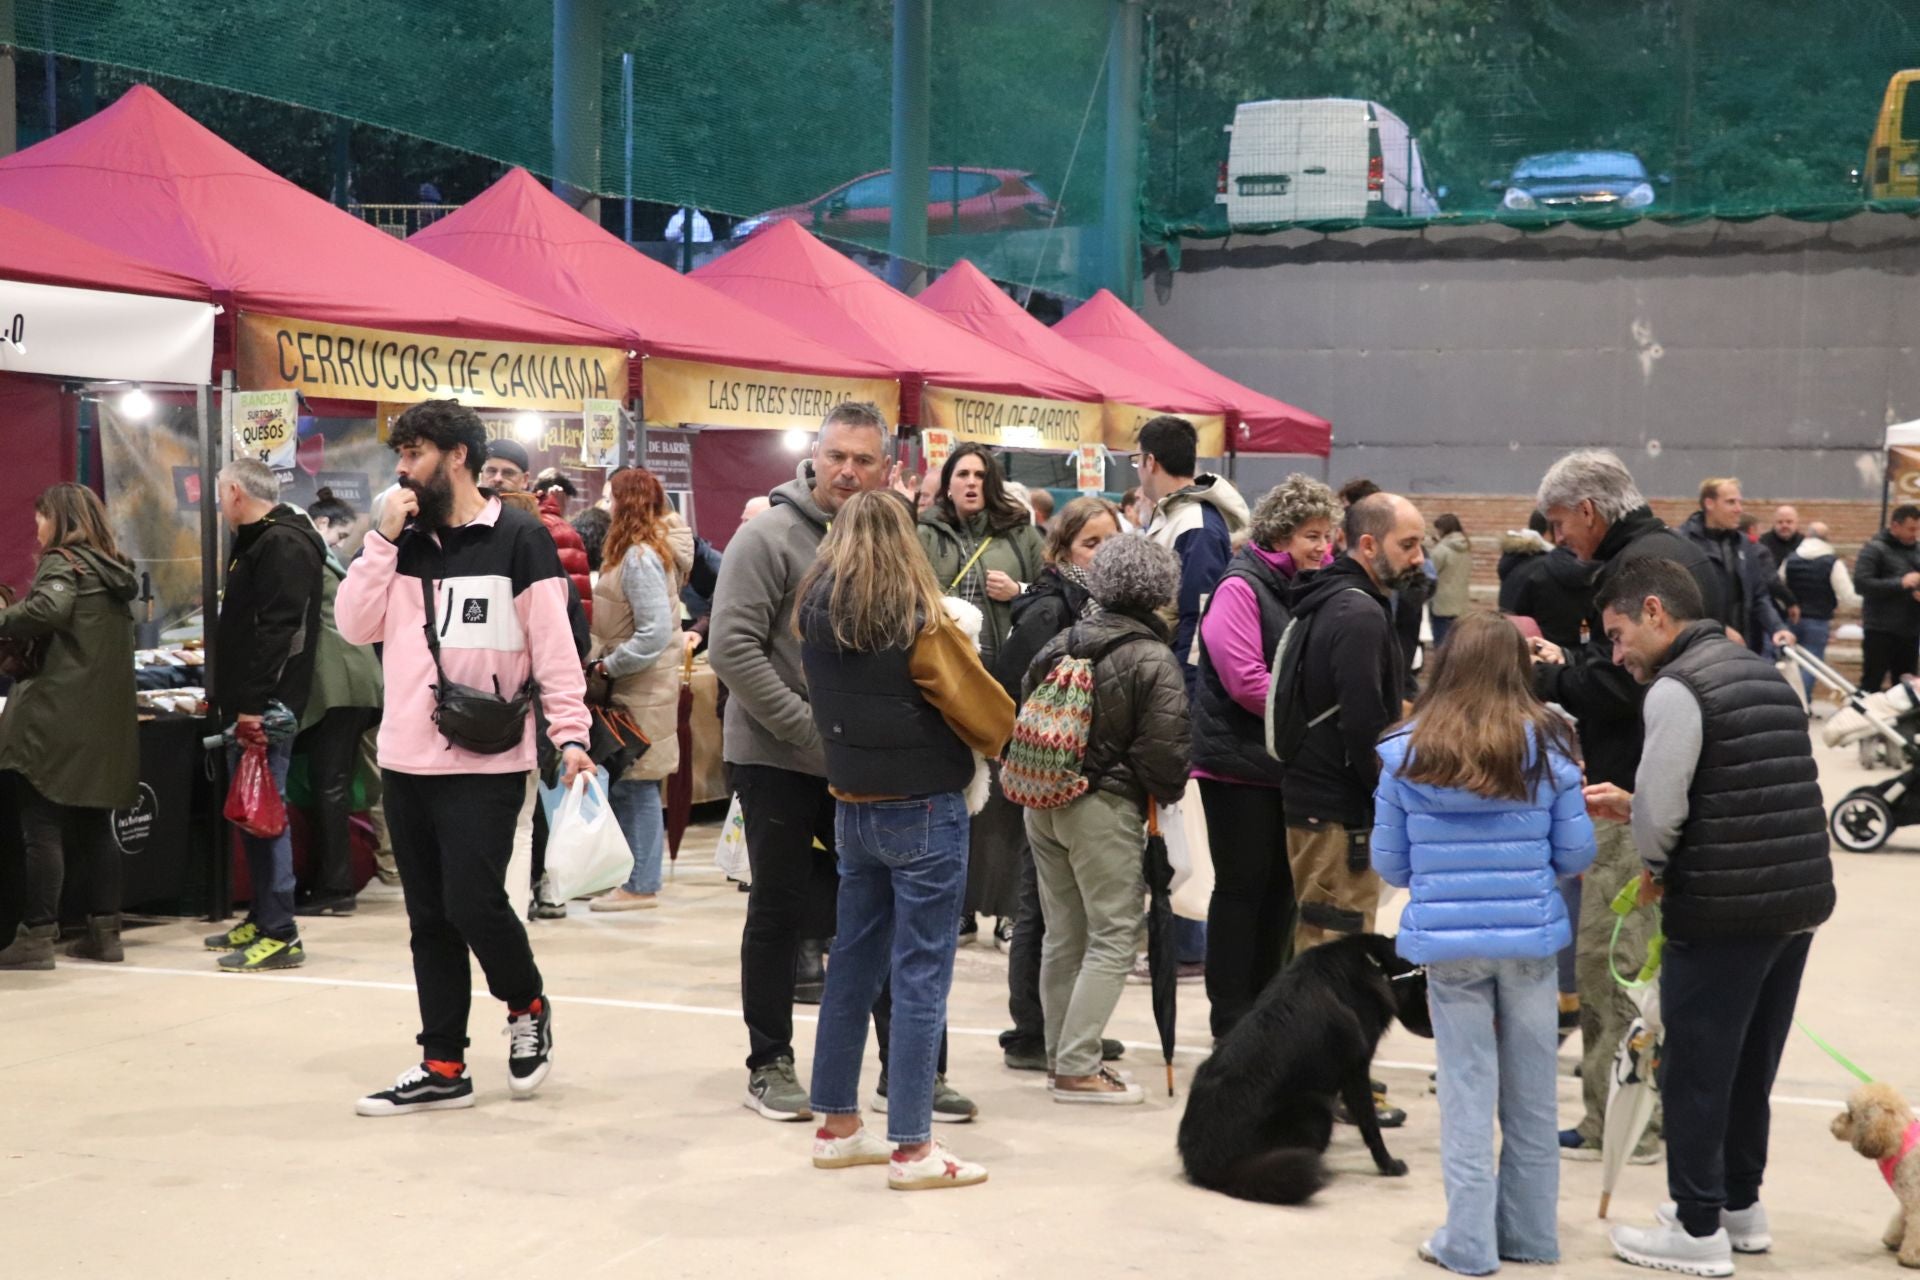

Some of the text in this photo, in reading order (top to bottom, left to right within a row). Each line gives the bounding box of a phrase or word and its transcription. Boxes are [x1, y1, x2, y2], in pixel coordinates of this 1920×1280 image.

[276, 329, 609, 400] CERRUCOS DE CANAMA
[708, 379, 741, 411] LAS
[746, 383, 787, 415] TRES
[243, 424, 284, 444] QUESOS
[954, 397, 1081, 442] TIERRA DE BARROS
